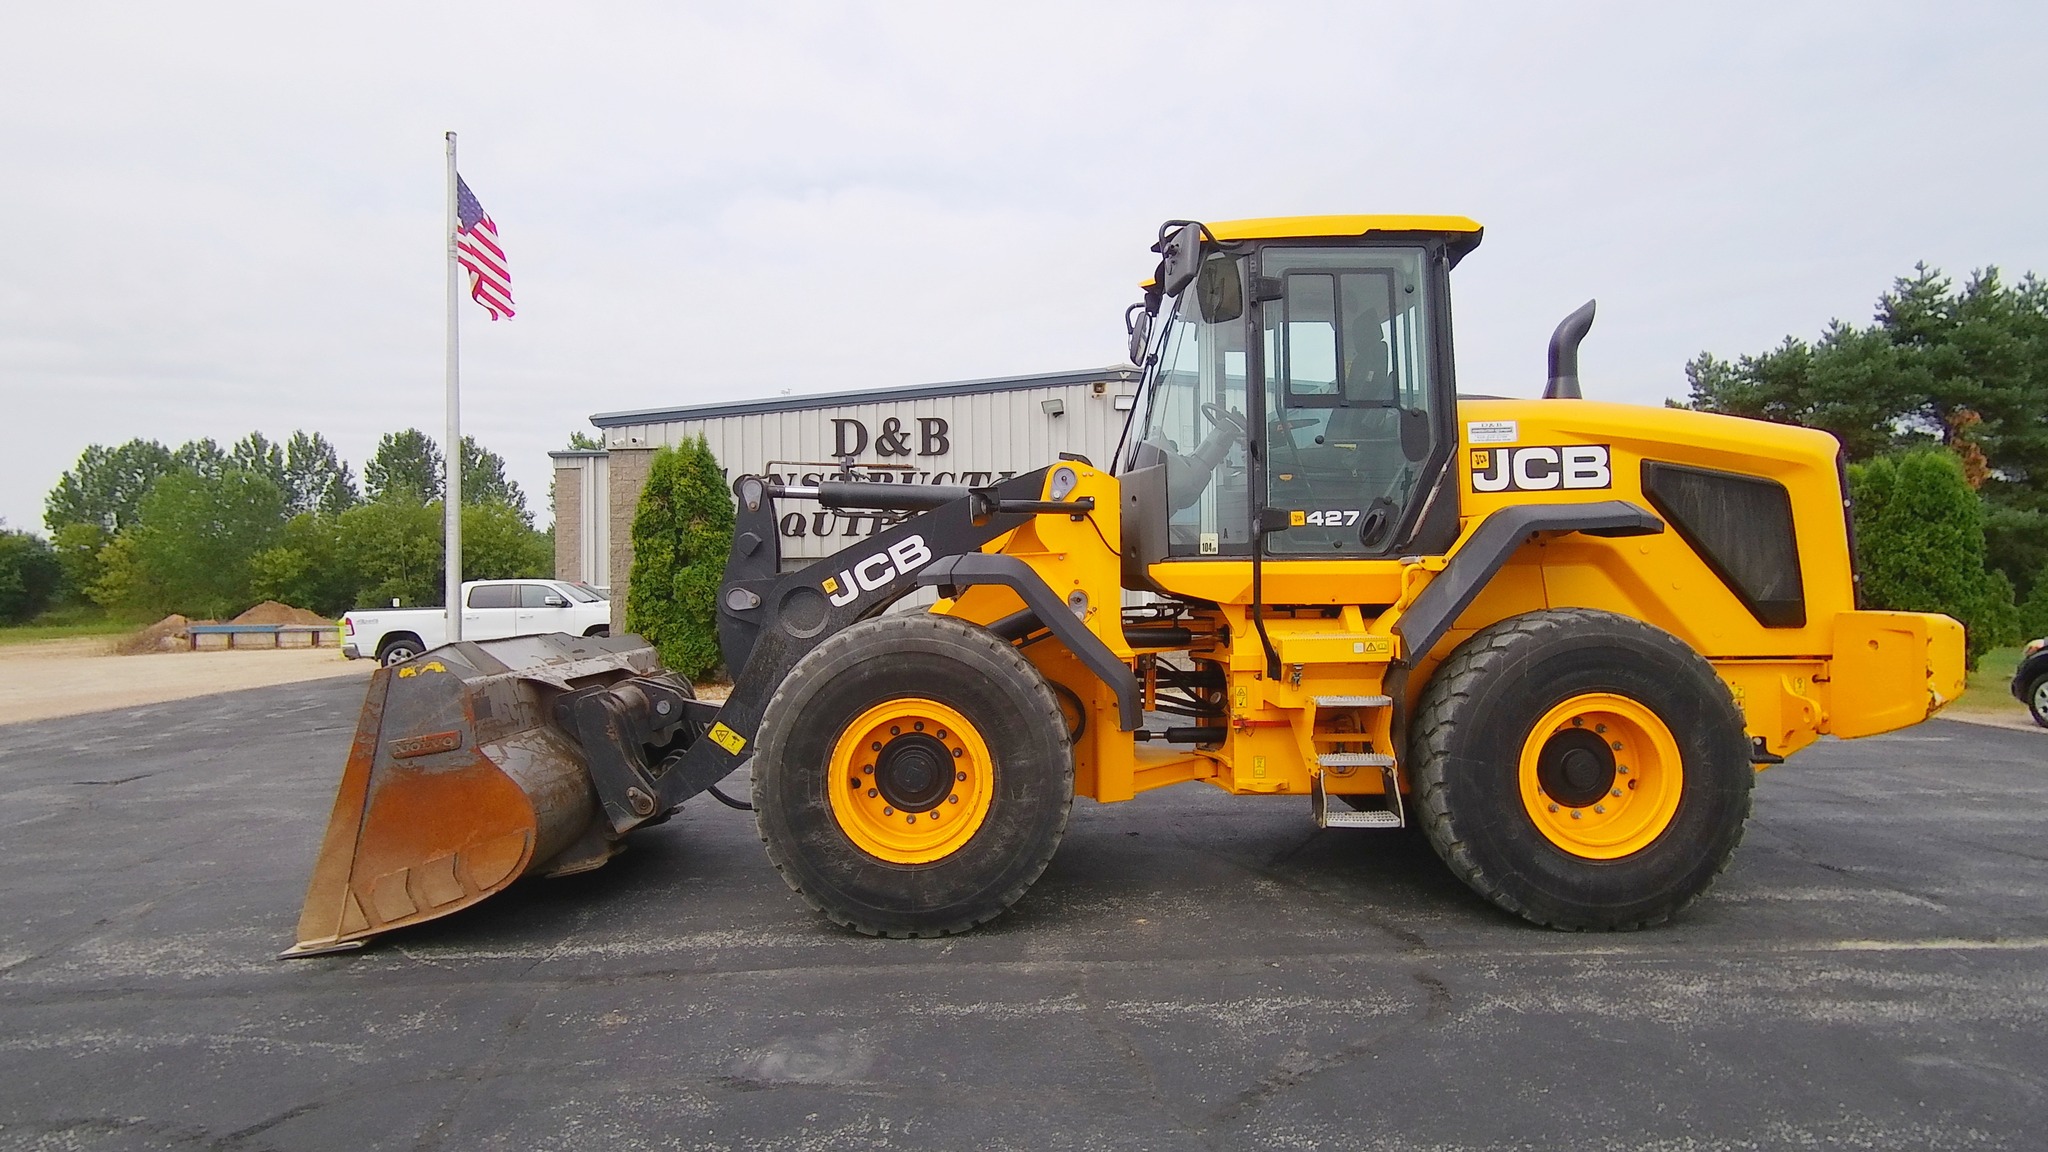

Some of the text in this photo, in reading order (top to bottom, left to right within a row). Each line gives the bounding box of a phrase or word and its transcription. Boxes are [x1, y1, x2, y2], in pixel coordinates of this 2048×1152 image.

[830, 417, 950, 457] D&B
[1472, 446, 1610, 491] JCB
[1306, 510, 1360, 526] 427
[829, 534, 932, 607] JCB
